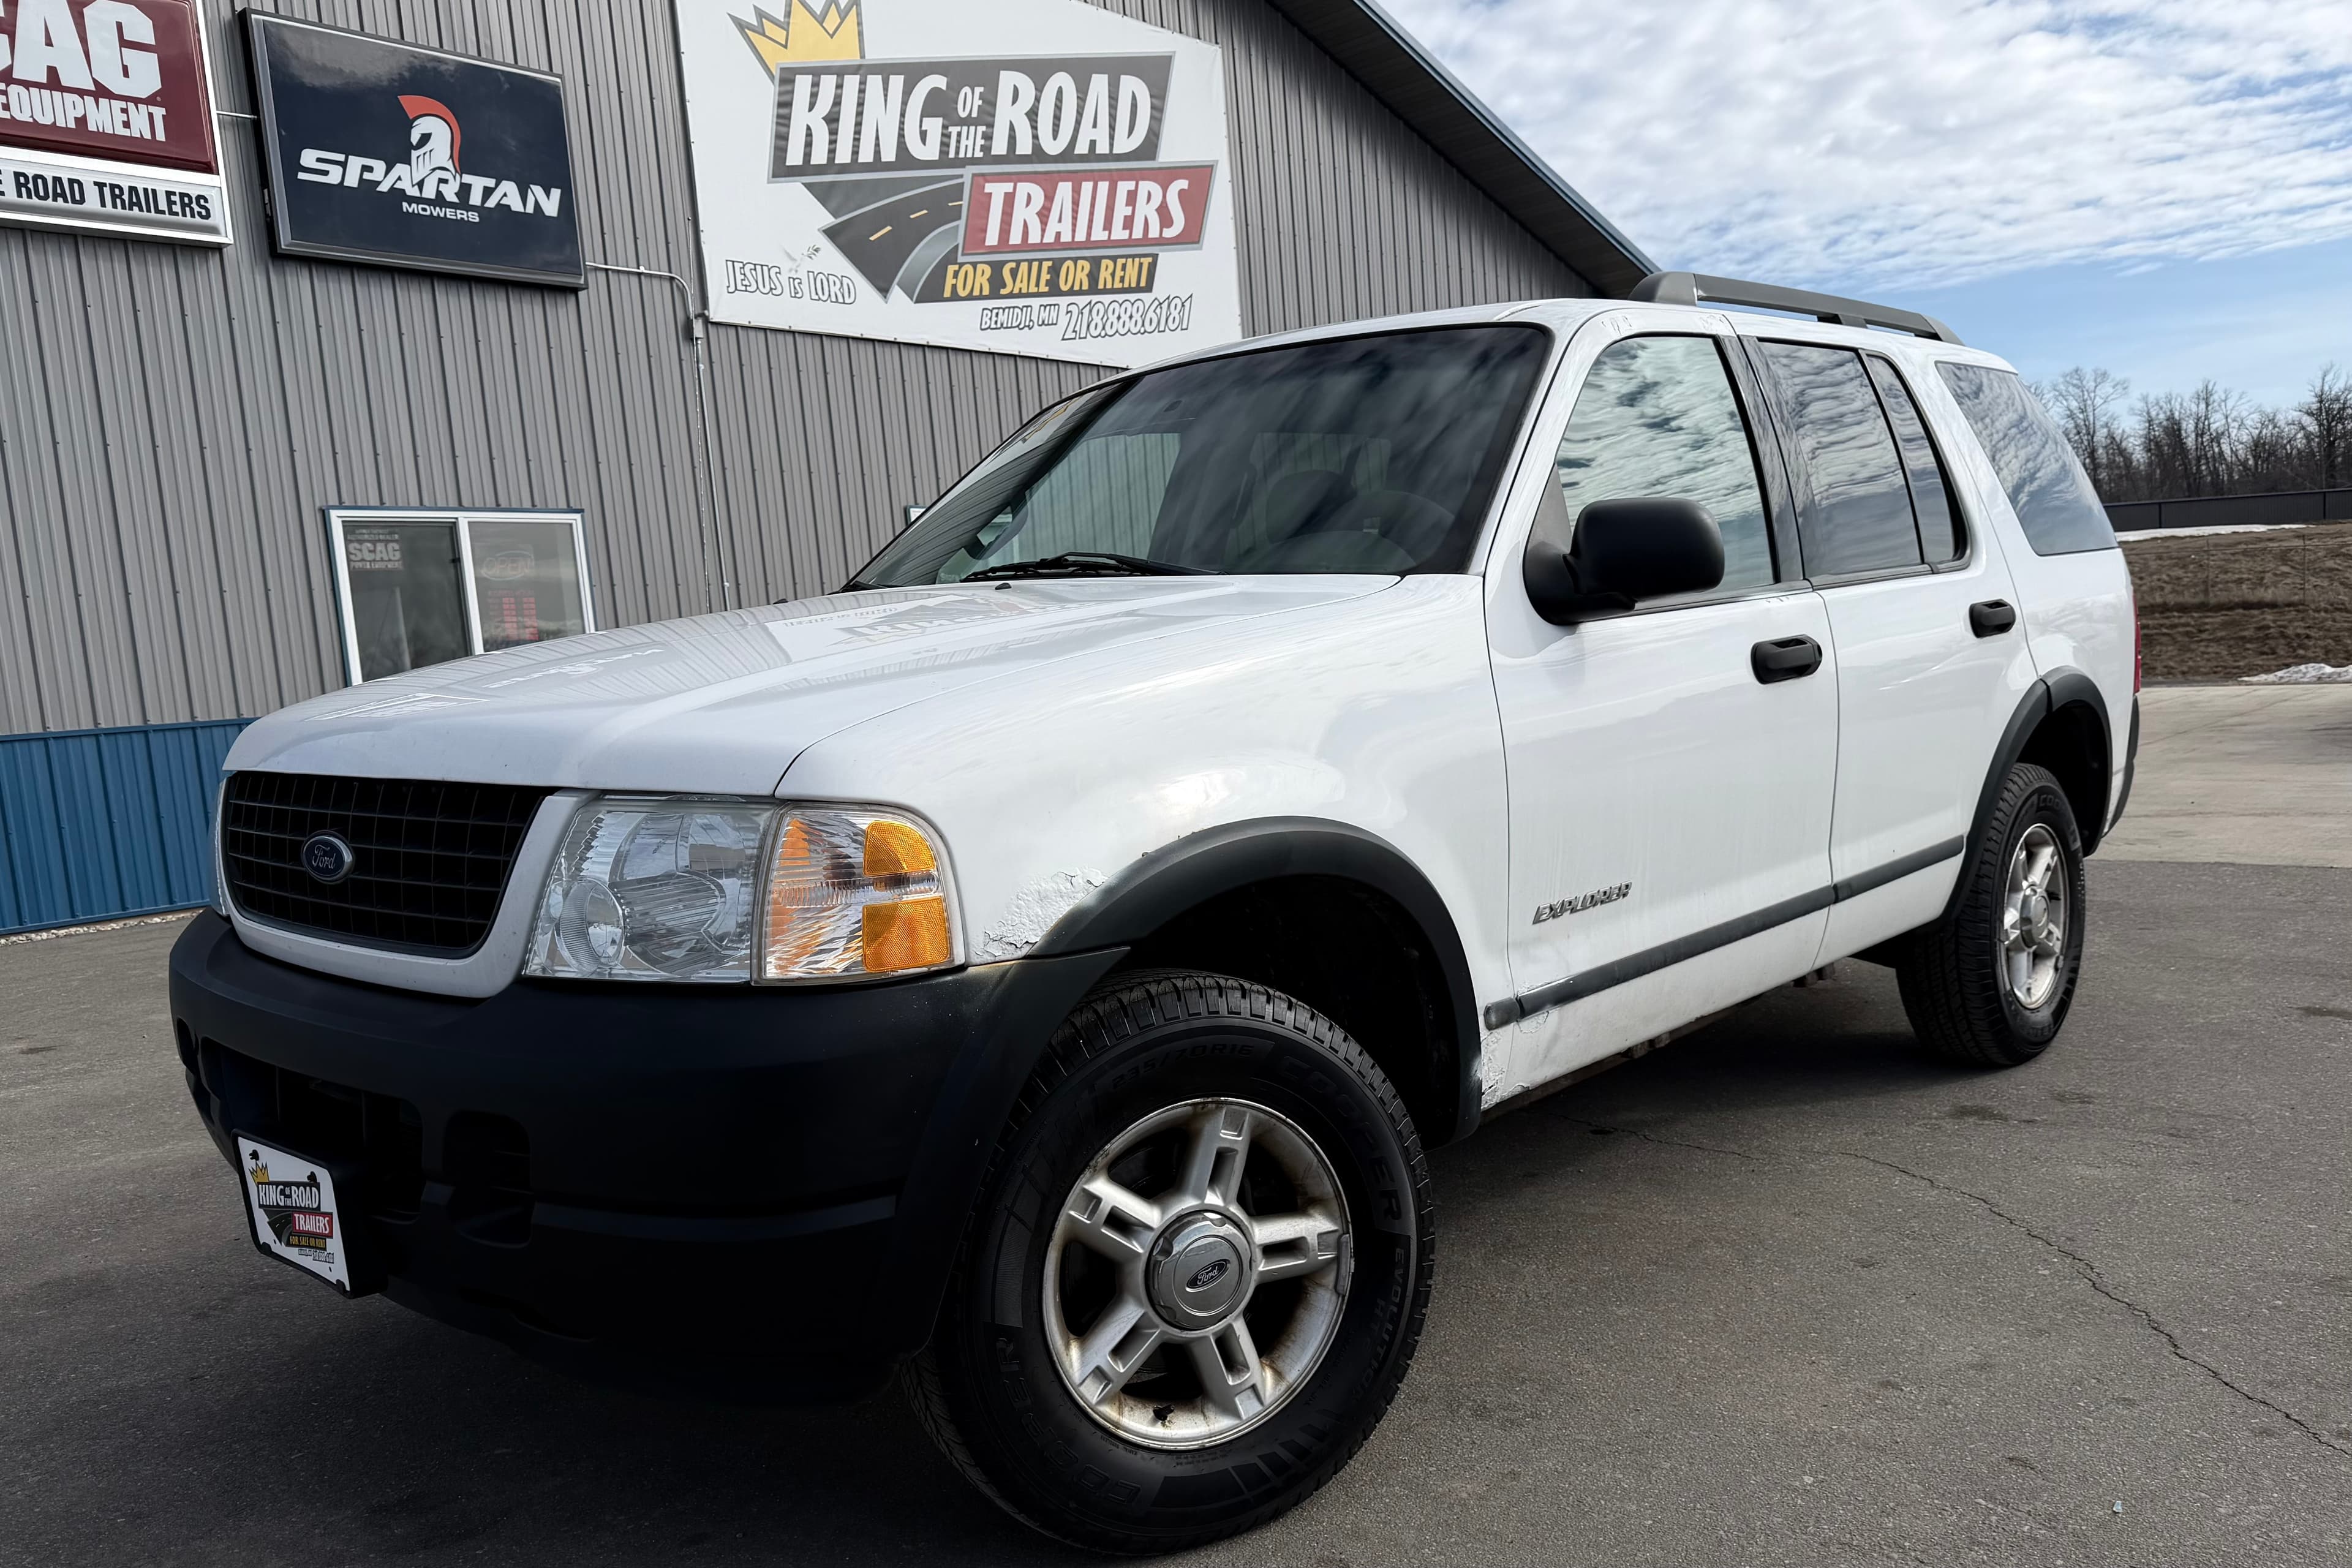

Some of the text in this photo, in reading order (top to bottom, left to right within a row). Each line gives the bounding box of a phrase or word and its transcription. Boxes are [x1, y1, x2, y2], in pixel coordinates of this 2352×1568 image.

[0, 0, 162, 99] AG
[785, 70, 1152, 166] KING OF THE ROAD
[13, 170, 86, 205] ROAD
[93, 181, 211, 220] TRAILERS
[297, 148, 562, 217] SPARTAN
[402, 202, 480, 223] MOWERS
[984, 179, 1189, 246] TRAILERS
[726, 260, 856, 305] JESUS IS LORD
[943, 257, 1153, 298] FOR SALE OR RENT
[980, 293, 1193, 341] BEMIDJI, MN 218.888.6181
[349, 542, 401, 561] SCAG
[312, 844, 336, 869] Ford
[1532, 880, 1632, 925] EXPLORER
[258, 1185, 285, 1206] KING
[291, 1186, 319, 1208] ROAD
[290, 1236, 326, 1248] FOR SALE OR RENT
[294, 1214, 330, 1234] TRAILERS
[1197, 1266, 1219, 1285] Ford
